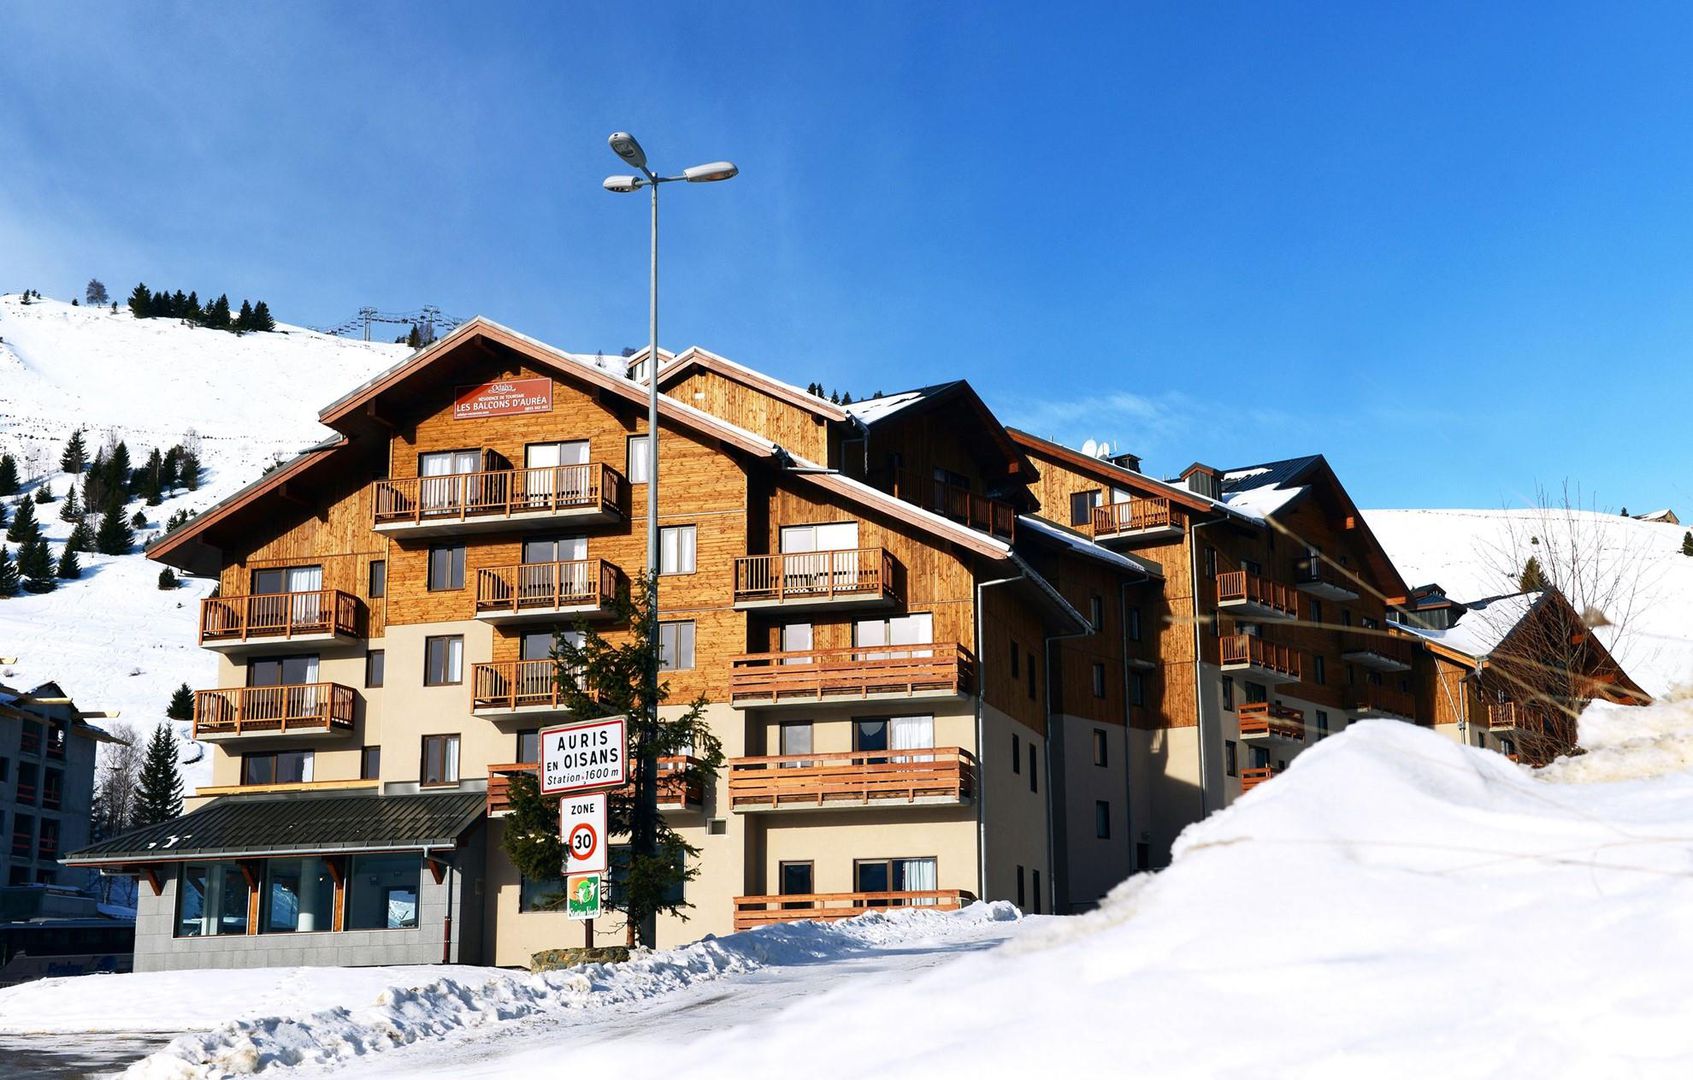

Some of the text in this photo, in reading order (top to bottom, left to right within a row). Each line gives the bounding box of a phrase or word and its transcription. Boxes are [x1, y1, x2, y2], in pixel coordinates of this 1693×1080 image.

[456, 395, 547, 412] LES BALCONS D'AURÉA
[557, 730, 608, 752] AURIS
[546, 747, 619, 772] EN OISANS
[547, 773, 580, 785] Station
[585, 767, 609, 780] 1600
[571, 803, 595, 815] ZONE
[574, 833, 592, 850] 30
